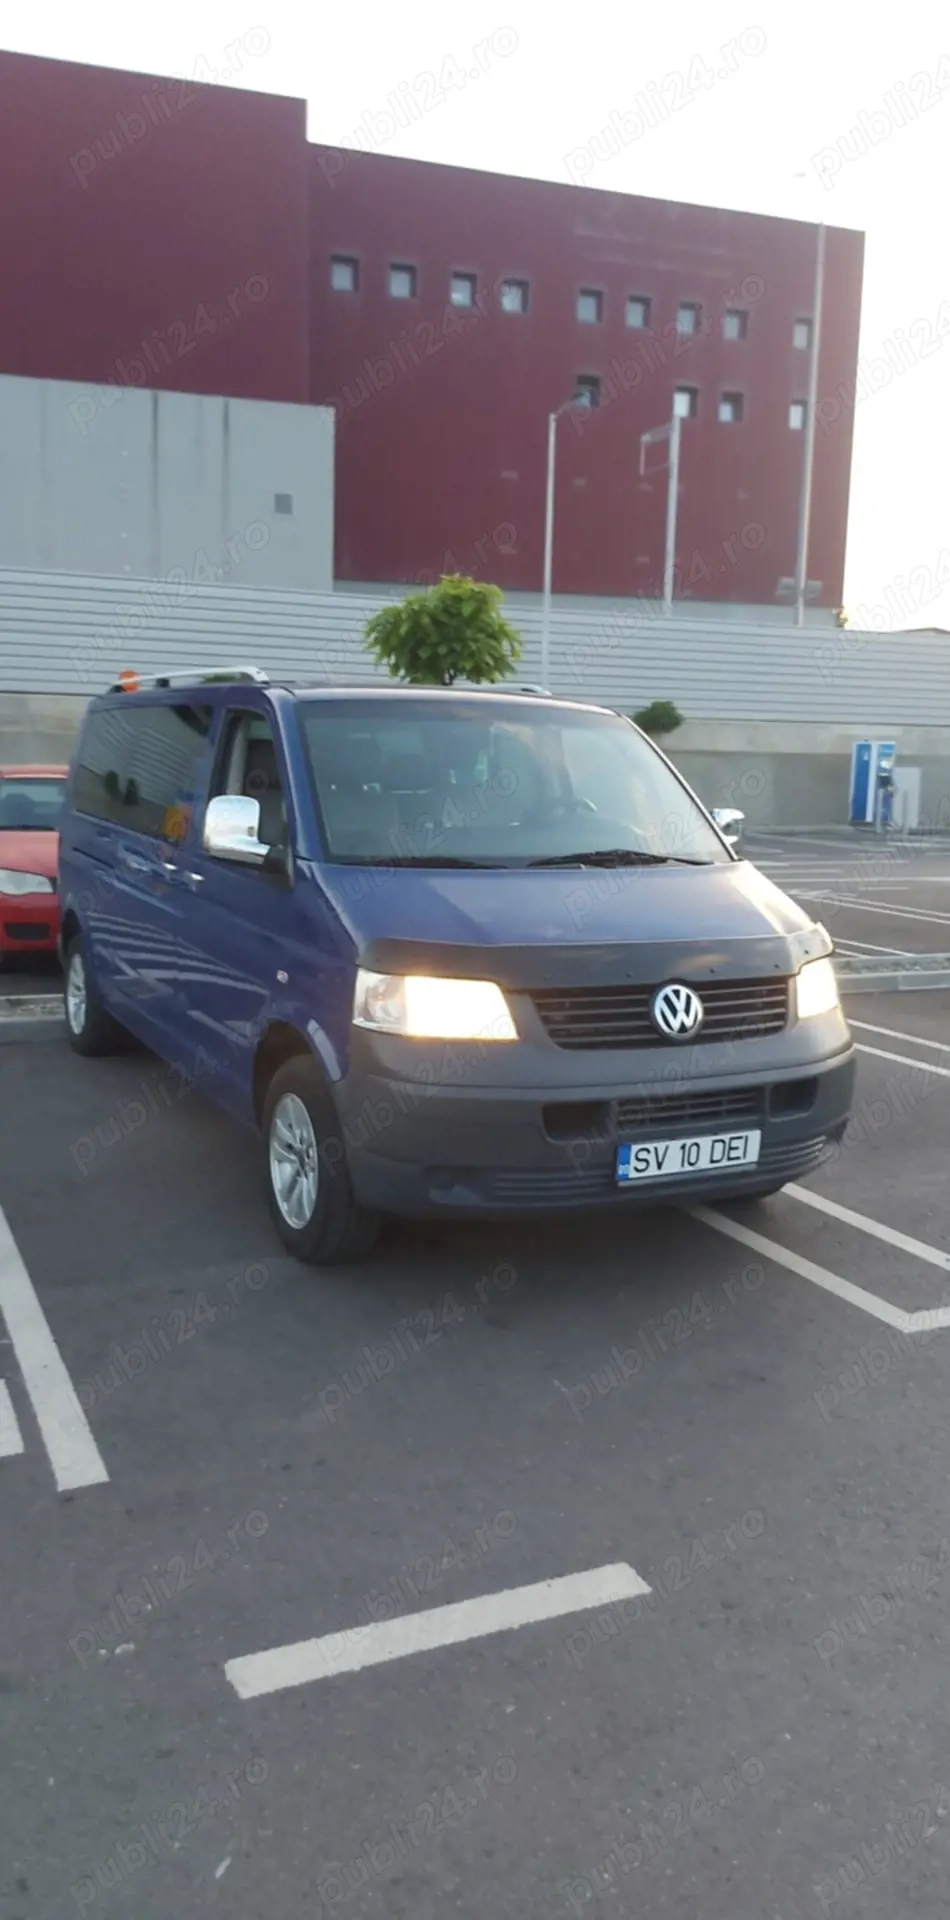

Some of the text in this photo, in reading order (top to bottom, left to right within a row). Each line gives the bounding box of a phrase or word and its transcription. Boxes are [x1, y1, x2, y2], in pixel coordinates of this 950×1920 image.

[654, 984, 703, 1036] VW
[633, 1146, 669, 1173] SV
[680, 1142, 701, 1167] 10
[709, 1135, 748, 1164] DEI
